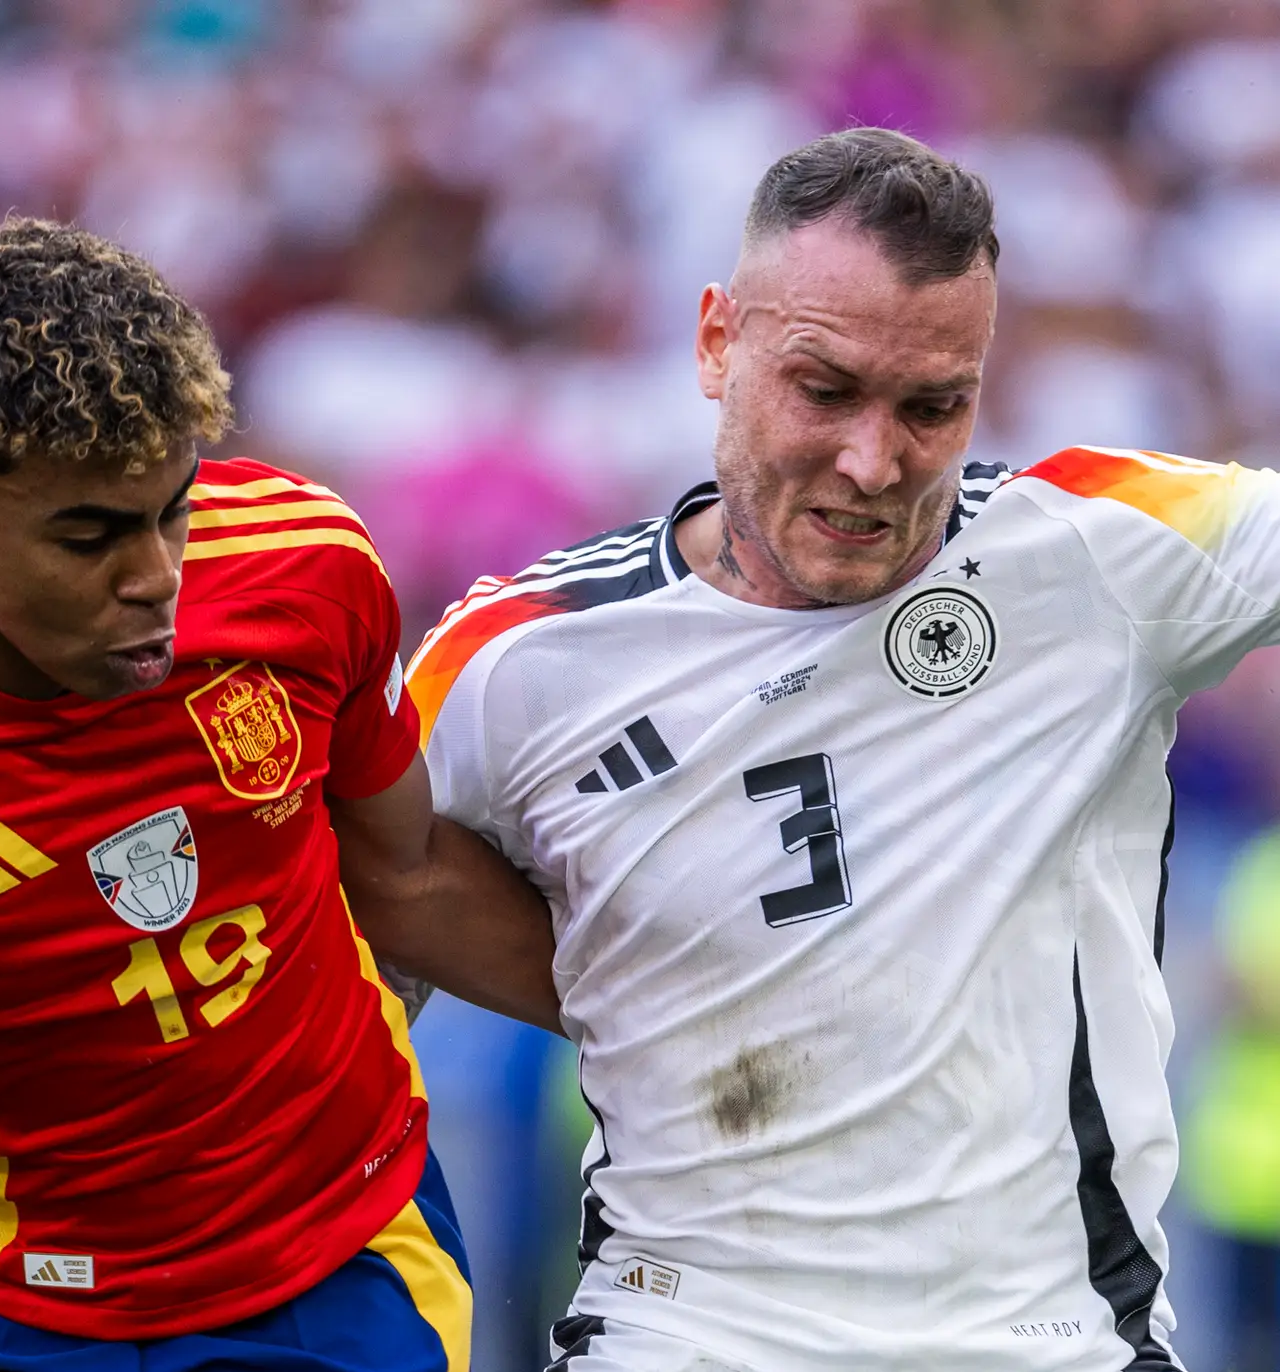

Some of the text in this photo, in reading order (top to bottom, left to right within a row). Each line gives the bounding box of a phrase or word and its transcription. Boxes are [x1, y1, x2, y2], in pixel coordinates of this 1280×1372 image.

[904, 602, 965, 630] DEUTSCHER
[780, 663, 818, 684] GERMANY
[906, 643, 982, 683] FUSSBALL-BUND
[759, 674, 811, 701] 05 JULY 2024
[765, 682, 806, 706] STUTTGART
[92, 811, 179, 857] UEFA NATIONS LEAGUE
[743, 752, 852, 928] 3
[144, 897, 190, 927] WINNER 2023
[111, 904, 272, 1043] 19
[1009, 1320, 1082, 1337] HEAT RDY
